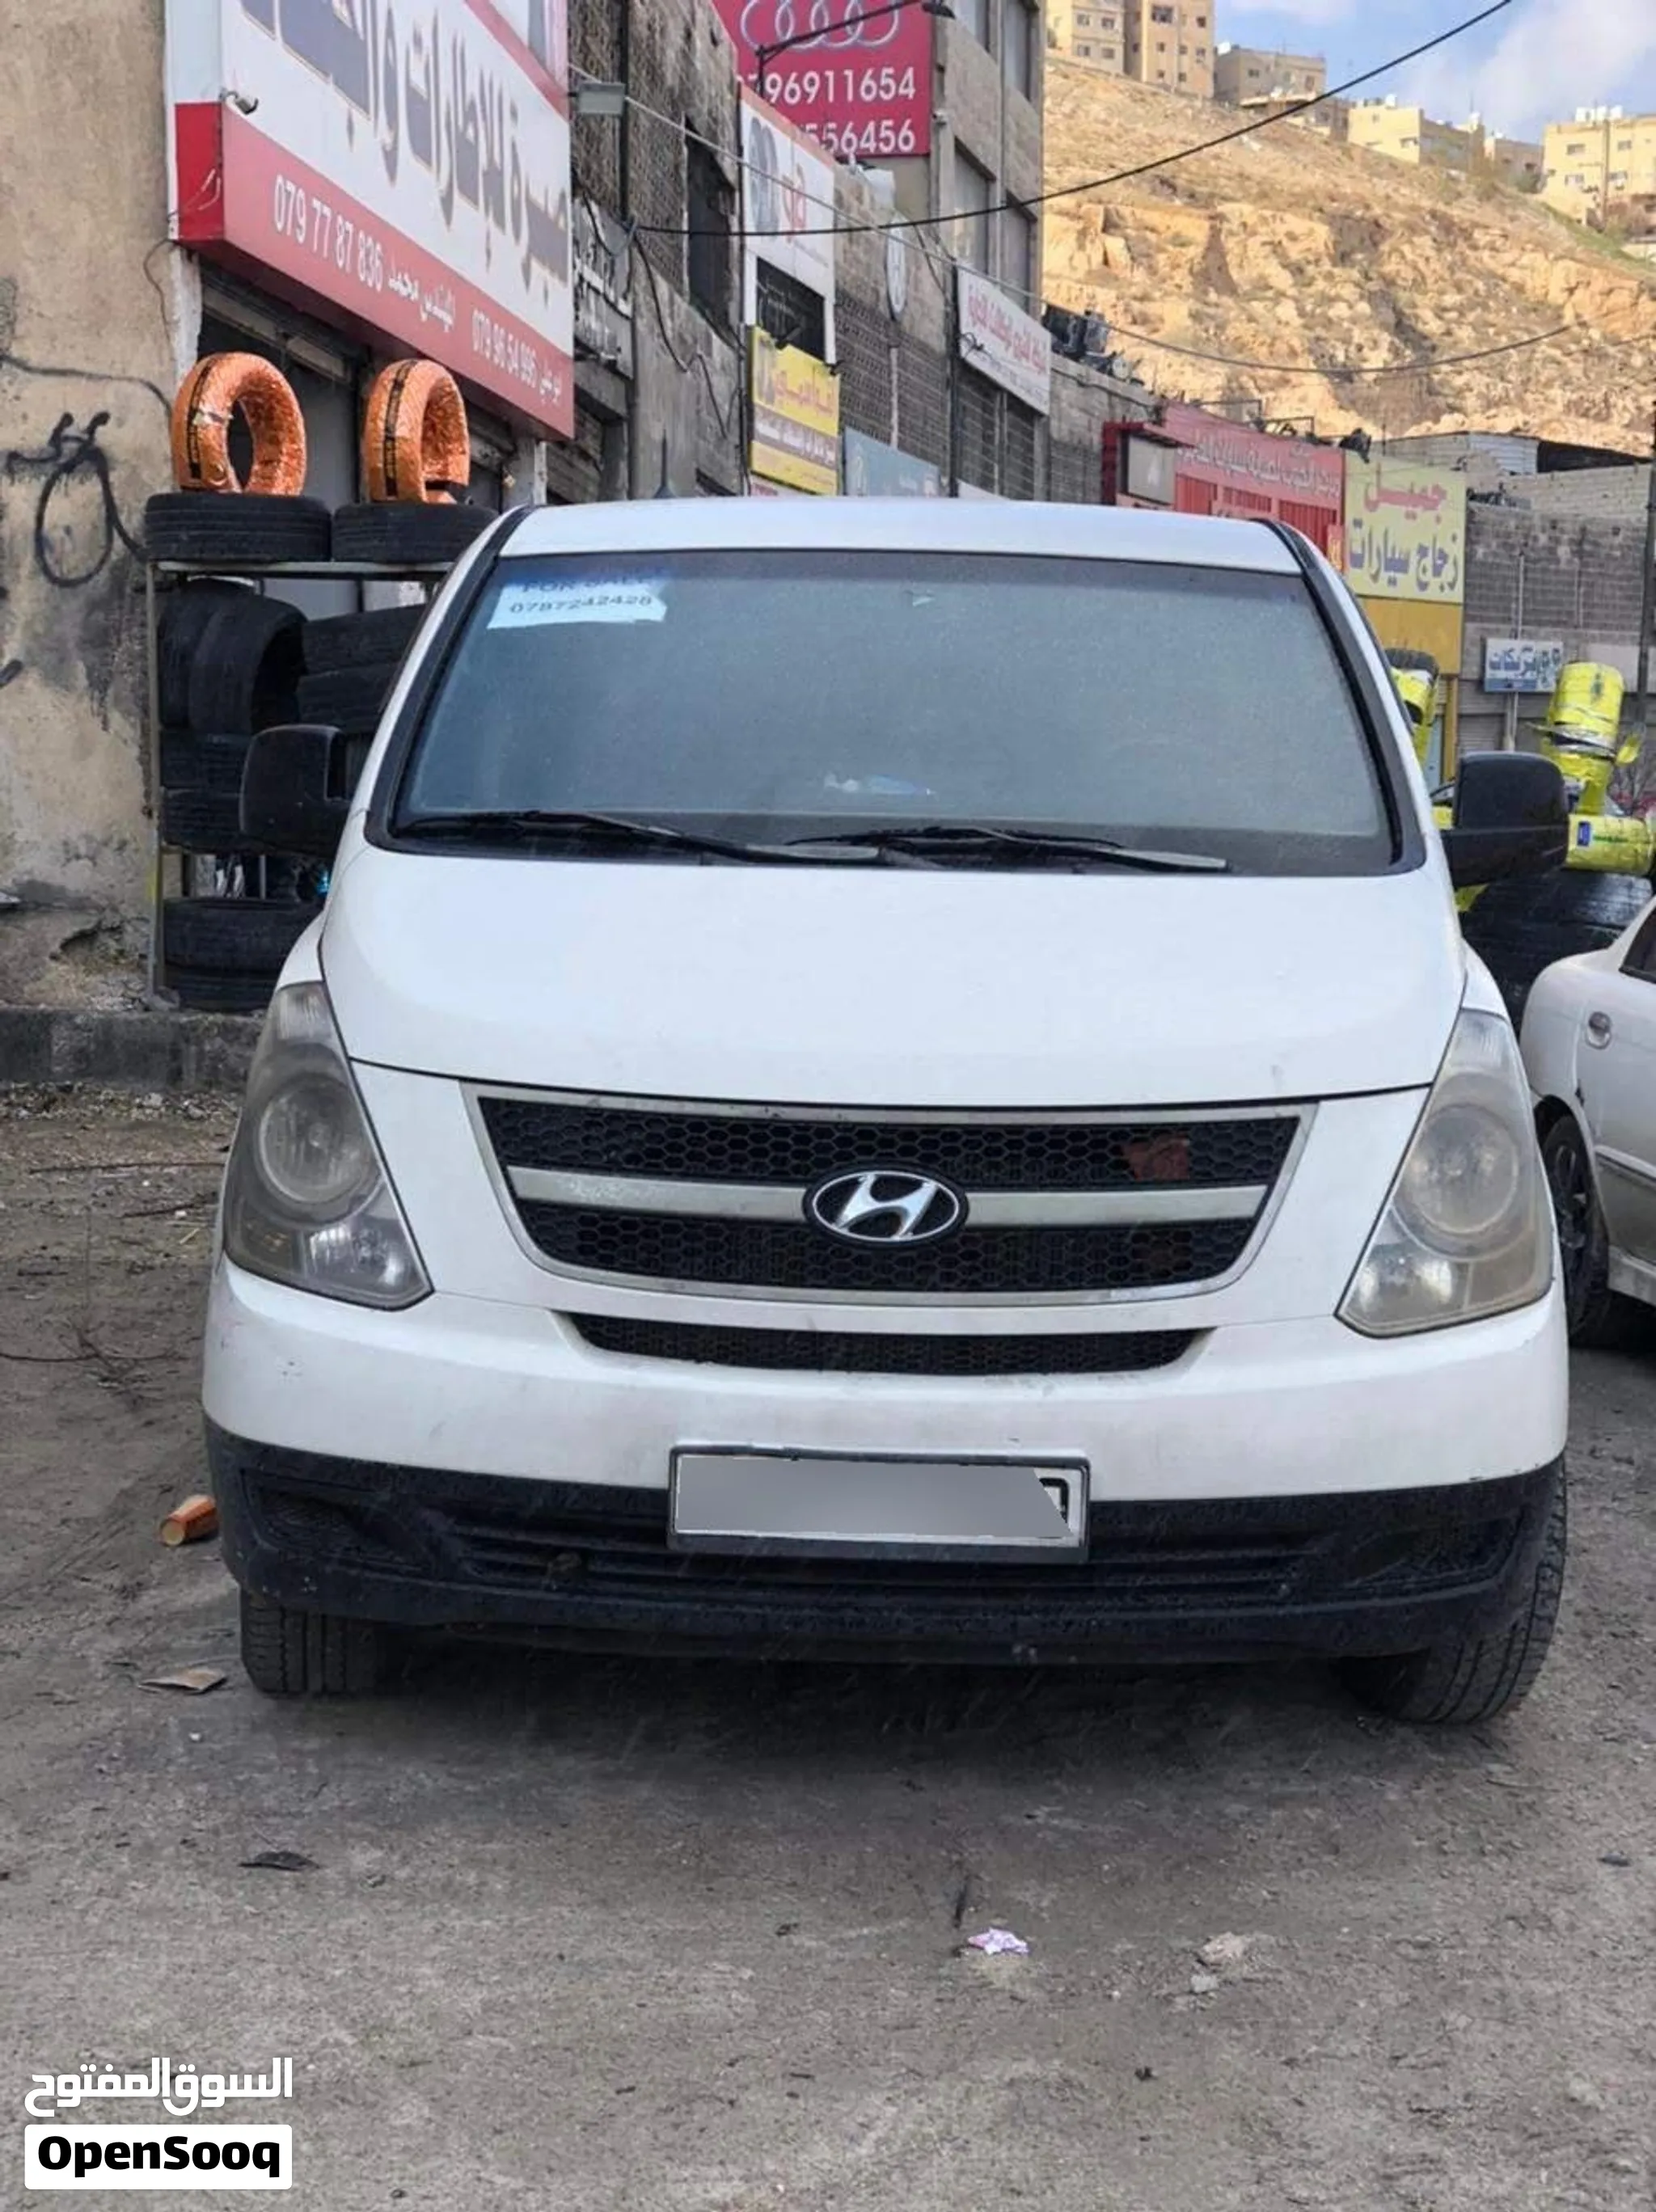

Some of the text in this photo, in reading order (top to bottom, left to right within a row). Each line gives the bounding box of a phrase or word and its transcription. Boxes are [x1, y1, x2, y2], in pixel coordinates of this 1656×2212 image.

[735, 65, 916, 105] 96911654
[274, 174, 306, 244] 079
[312, 197, 332, 259] 77
[335, 214, 354, 275] 87
[1349, 517, 1458, 593] زجاج سيارات
